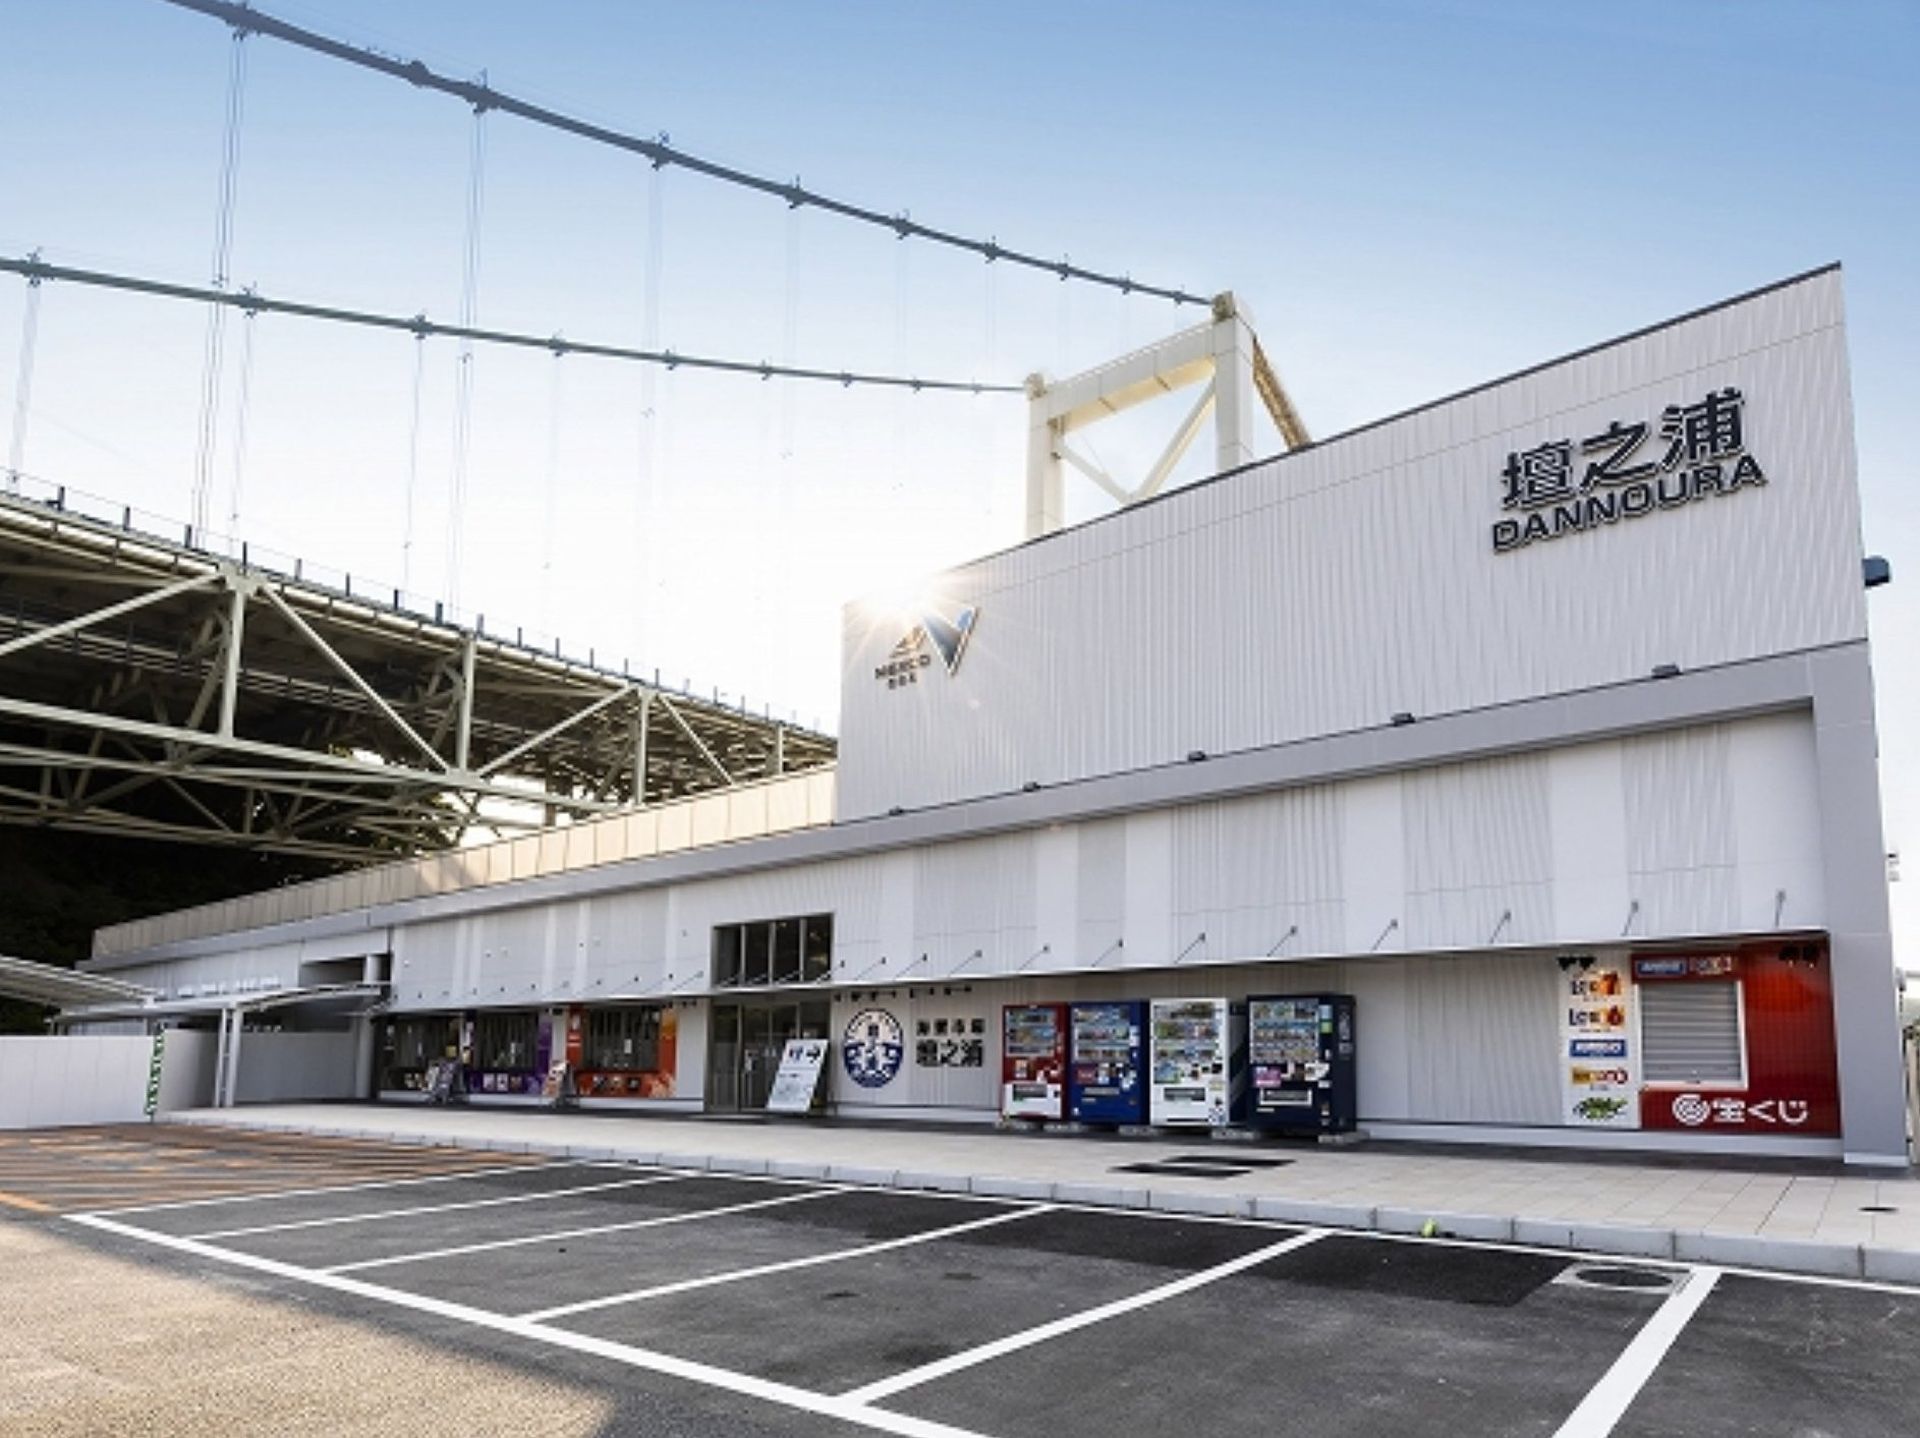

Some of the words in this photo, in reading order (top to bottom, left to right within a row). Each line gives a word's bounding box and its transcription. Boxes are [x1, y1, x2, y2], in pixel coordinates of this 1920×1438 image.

[1502, 387, 1745, 509] 壇之浦
[1493, 454, 1767, 553] DANNOURA
[1712, 1096, 1808, 1125] 宝くじ
